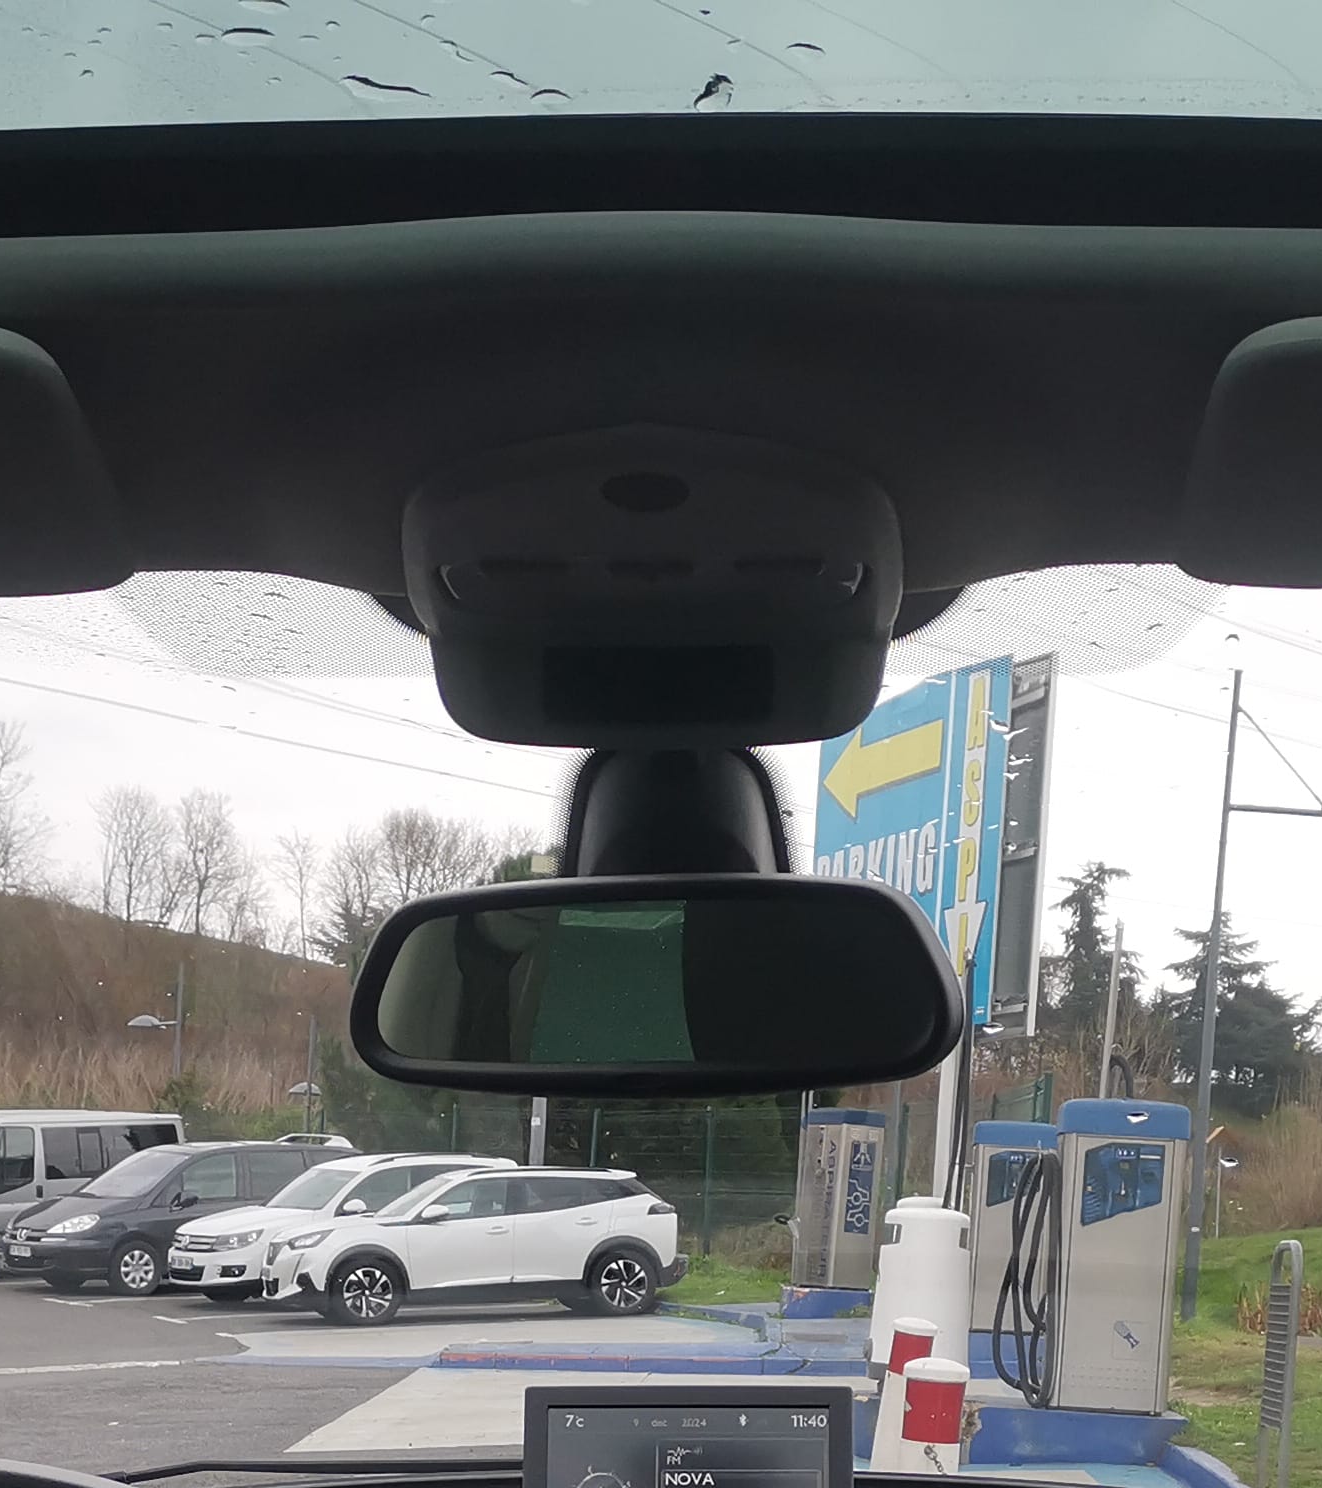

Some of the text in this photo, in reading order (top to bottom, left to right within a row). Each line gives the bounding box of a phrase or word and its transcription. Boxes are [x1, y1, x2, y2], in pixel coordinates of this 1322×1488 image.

[956, 677, 986, 978] ASPI
[791, 1414, 827, 1428] 11:40
[666, 1456, 681, 1465] FM
[665, 1473, 715, 1486] NOVA
